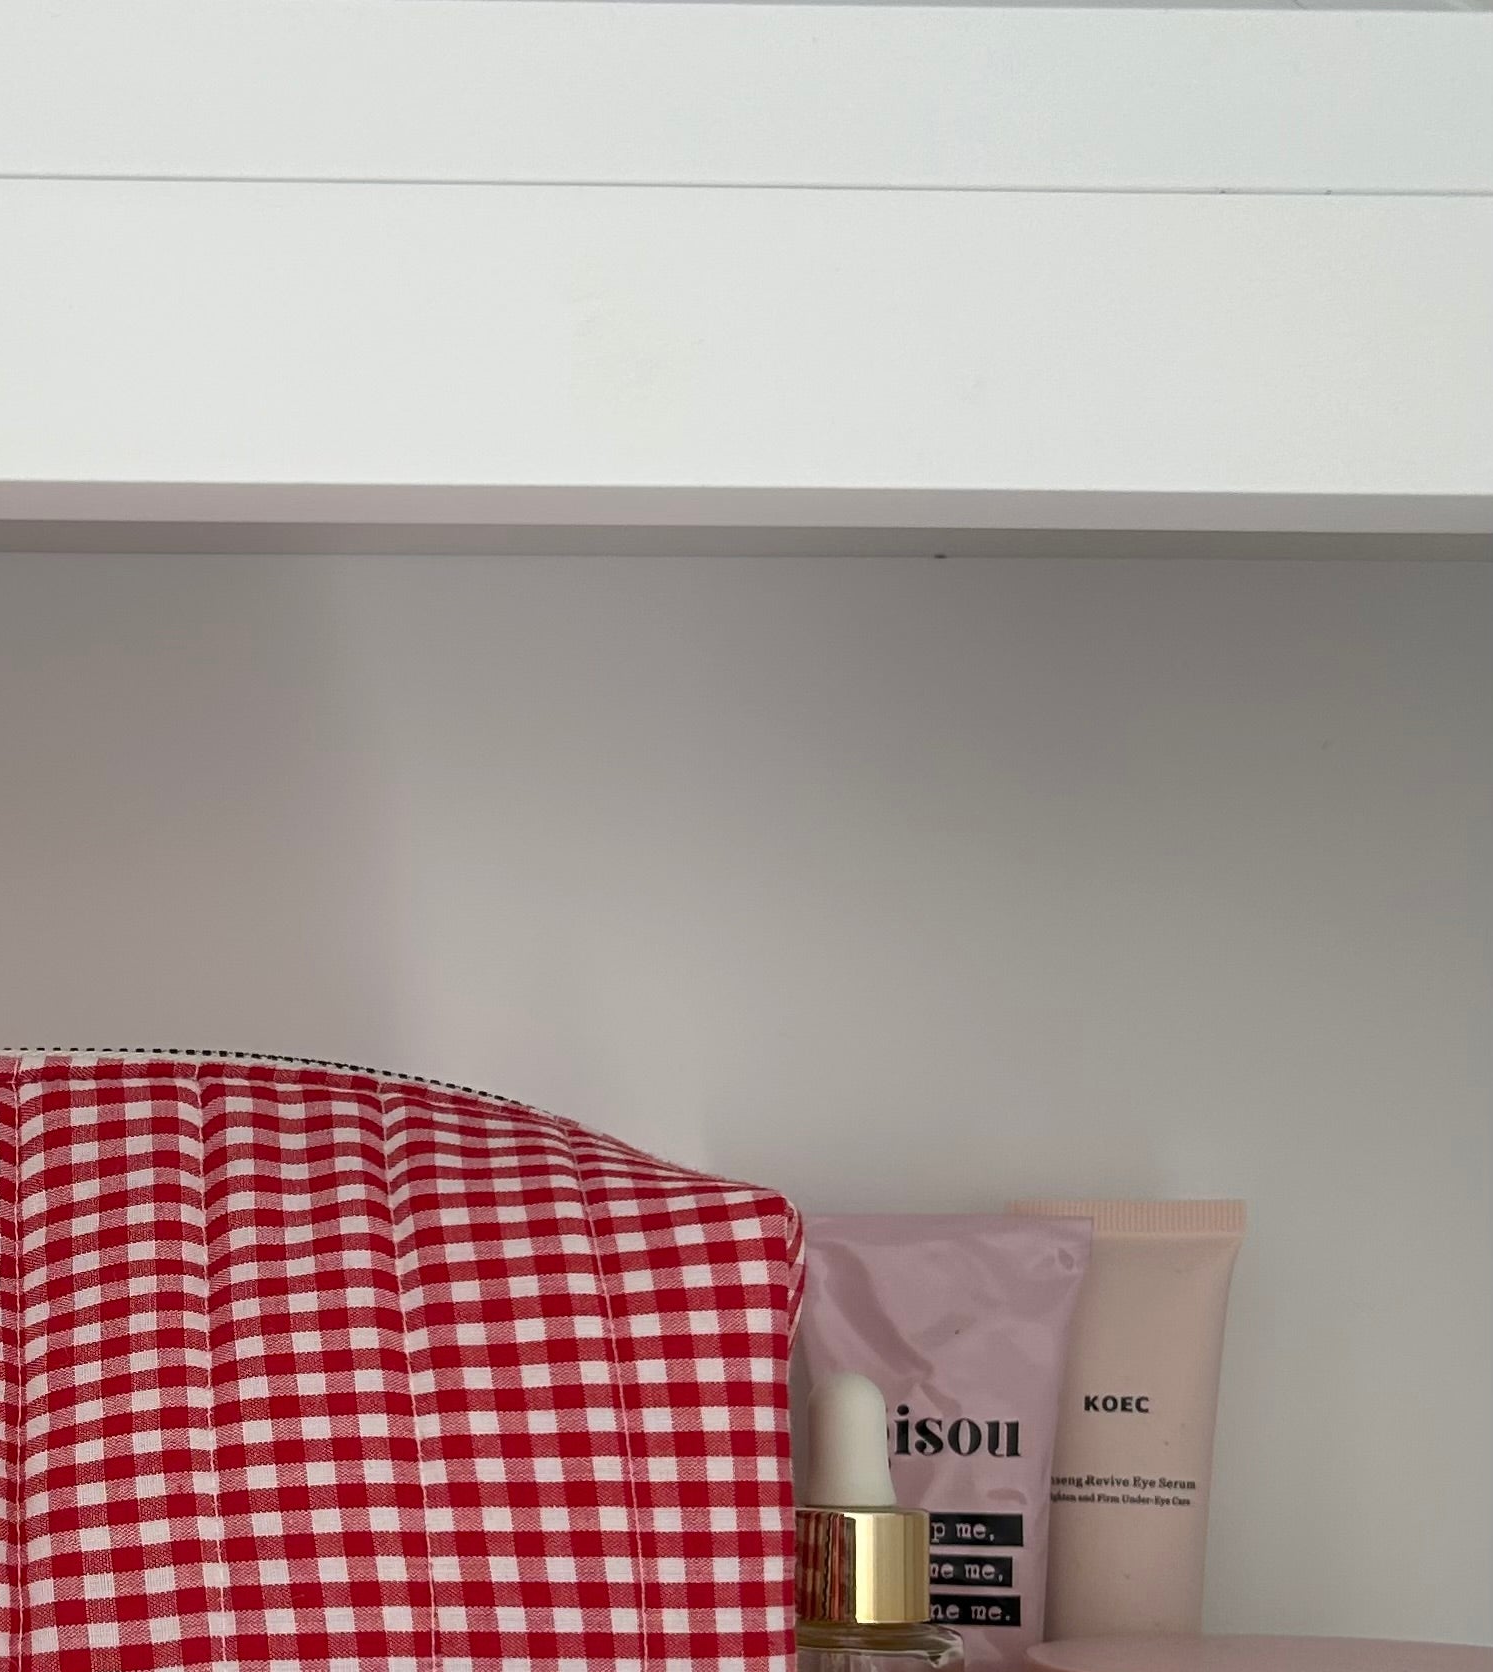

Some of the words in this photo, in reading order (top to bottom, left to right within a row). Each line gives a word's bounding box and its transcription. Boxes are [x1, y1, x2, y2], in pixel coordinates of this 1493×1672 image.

[1083, 1395, 1151, 1415] KOEC
[887, 1404, 1022, 1459] isou
[1085, 1474, 1130, 1488] Revive
[1132, 1475, 1156, 1490] Eye
[1158, 1477, 1197, 1490] Serum
[955, 1522, 995, 1542] me,
[964, 1562, 1004, 1583] me,
[971, 1604, 1011, 1621] me.
